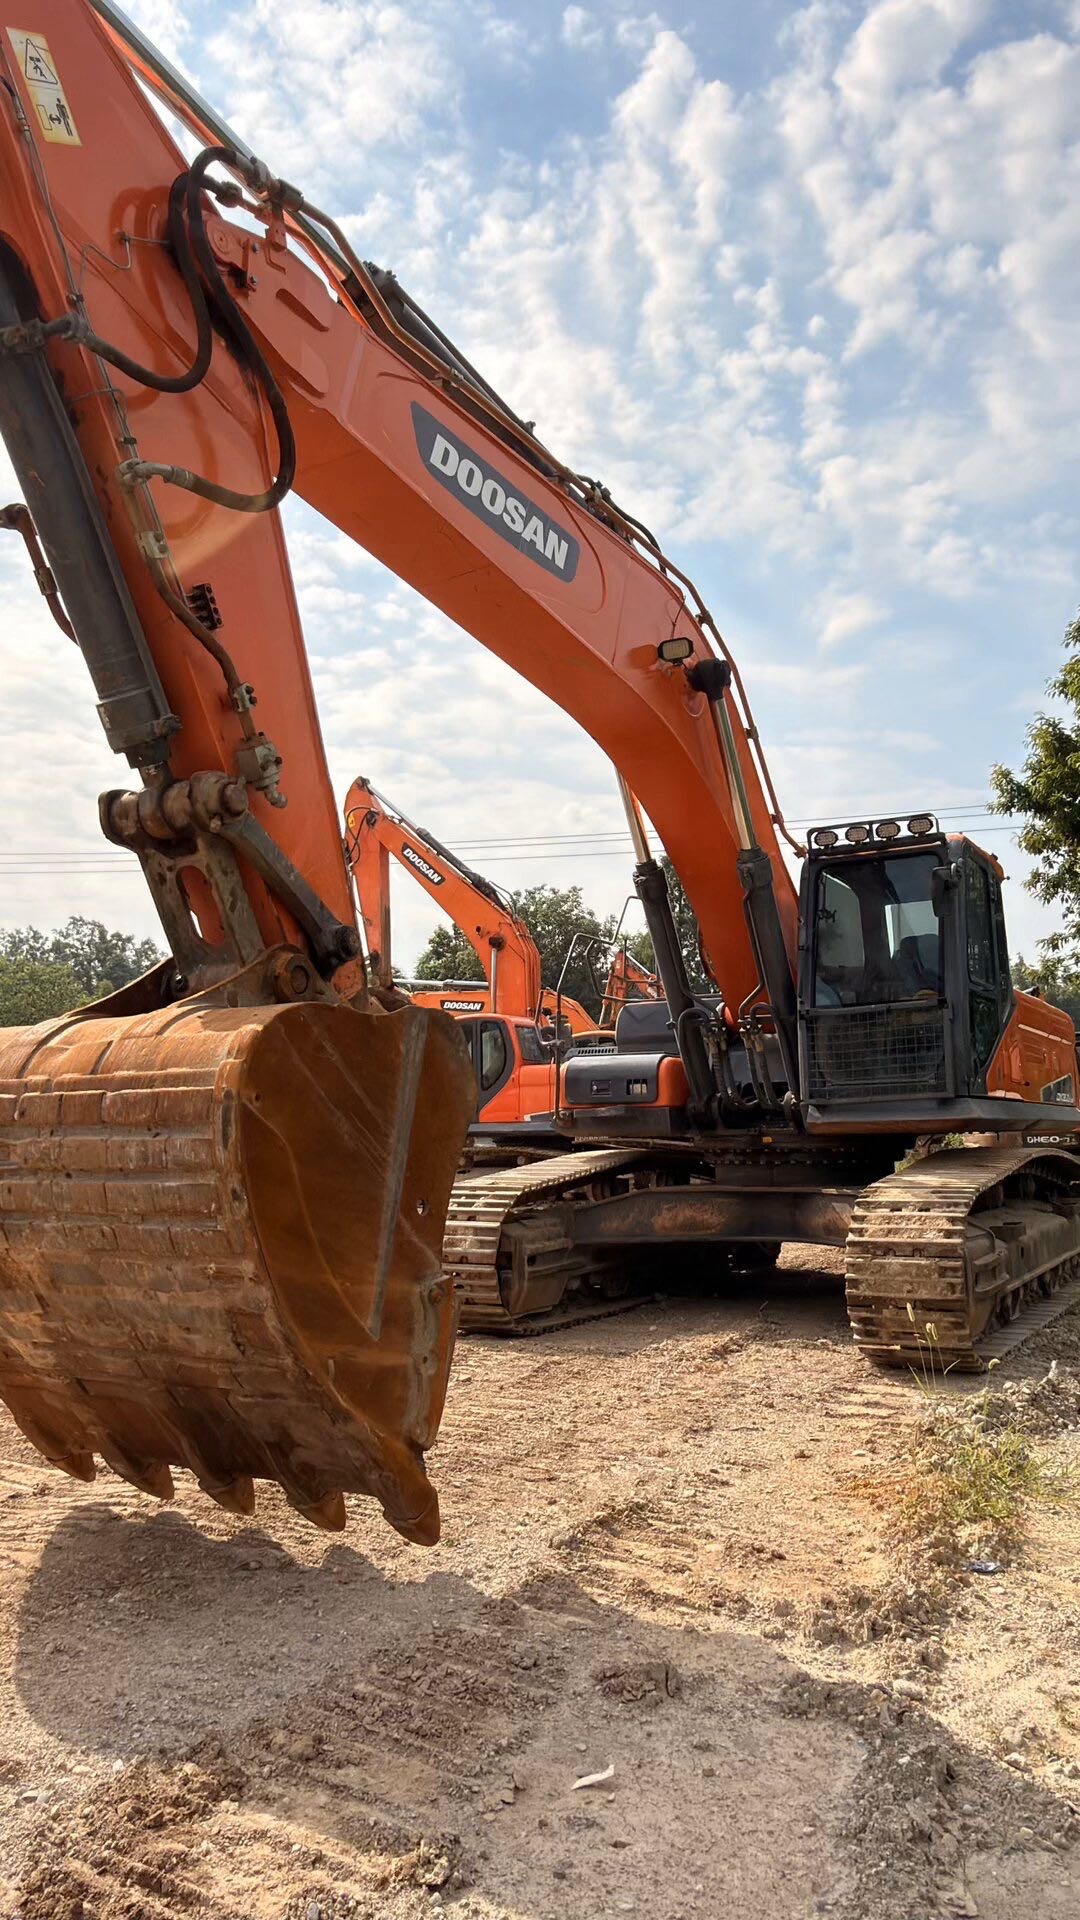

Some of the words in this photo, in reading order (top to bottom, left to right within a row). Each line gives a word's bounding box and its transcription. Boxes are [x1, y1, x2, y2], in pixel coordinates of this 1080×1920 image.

[429, 433, 569, 570] DOOSAN
[403, 848, 442, 883] DOOSAN
[443, 1001, 482, 1010] DOOSAN
